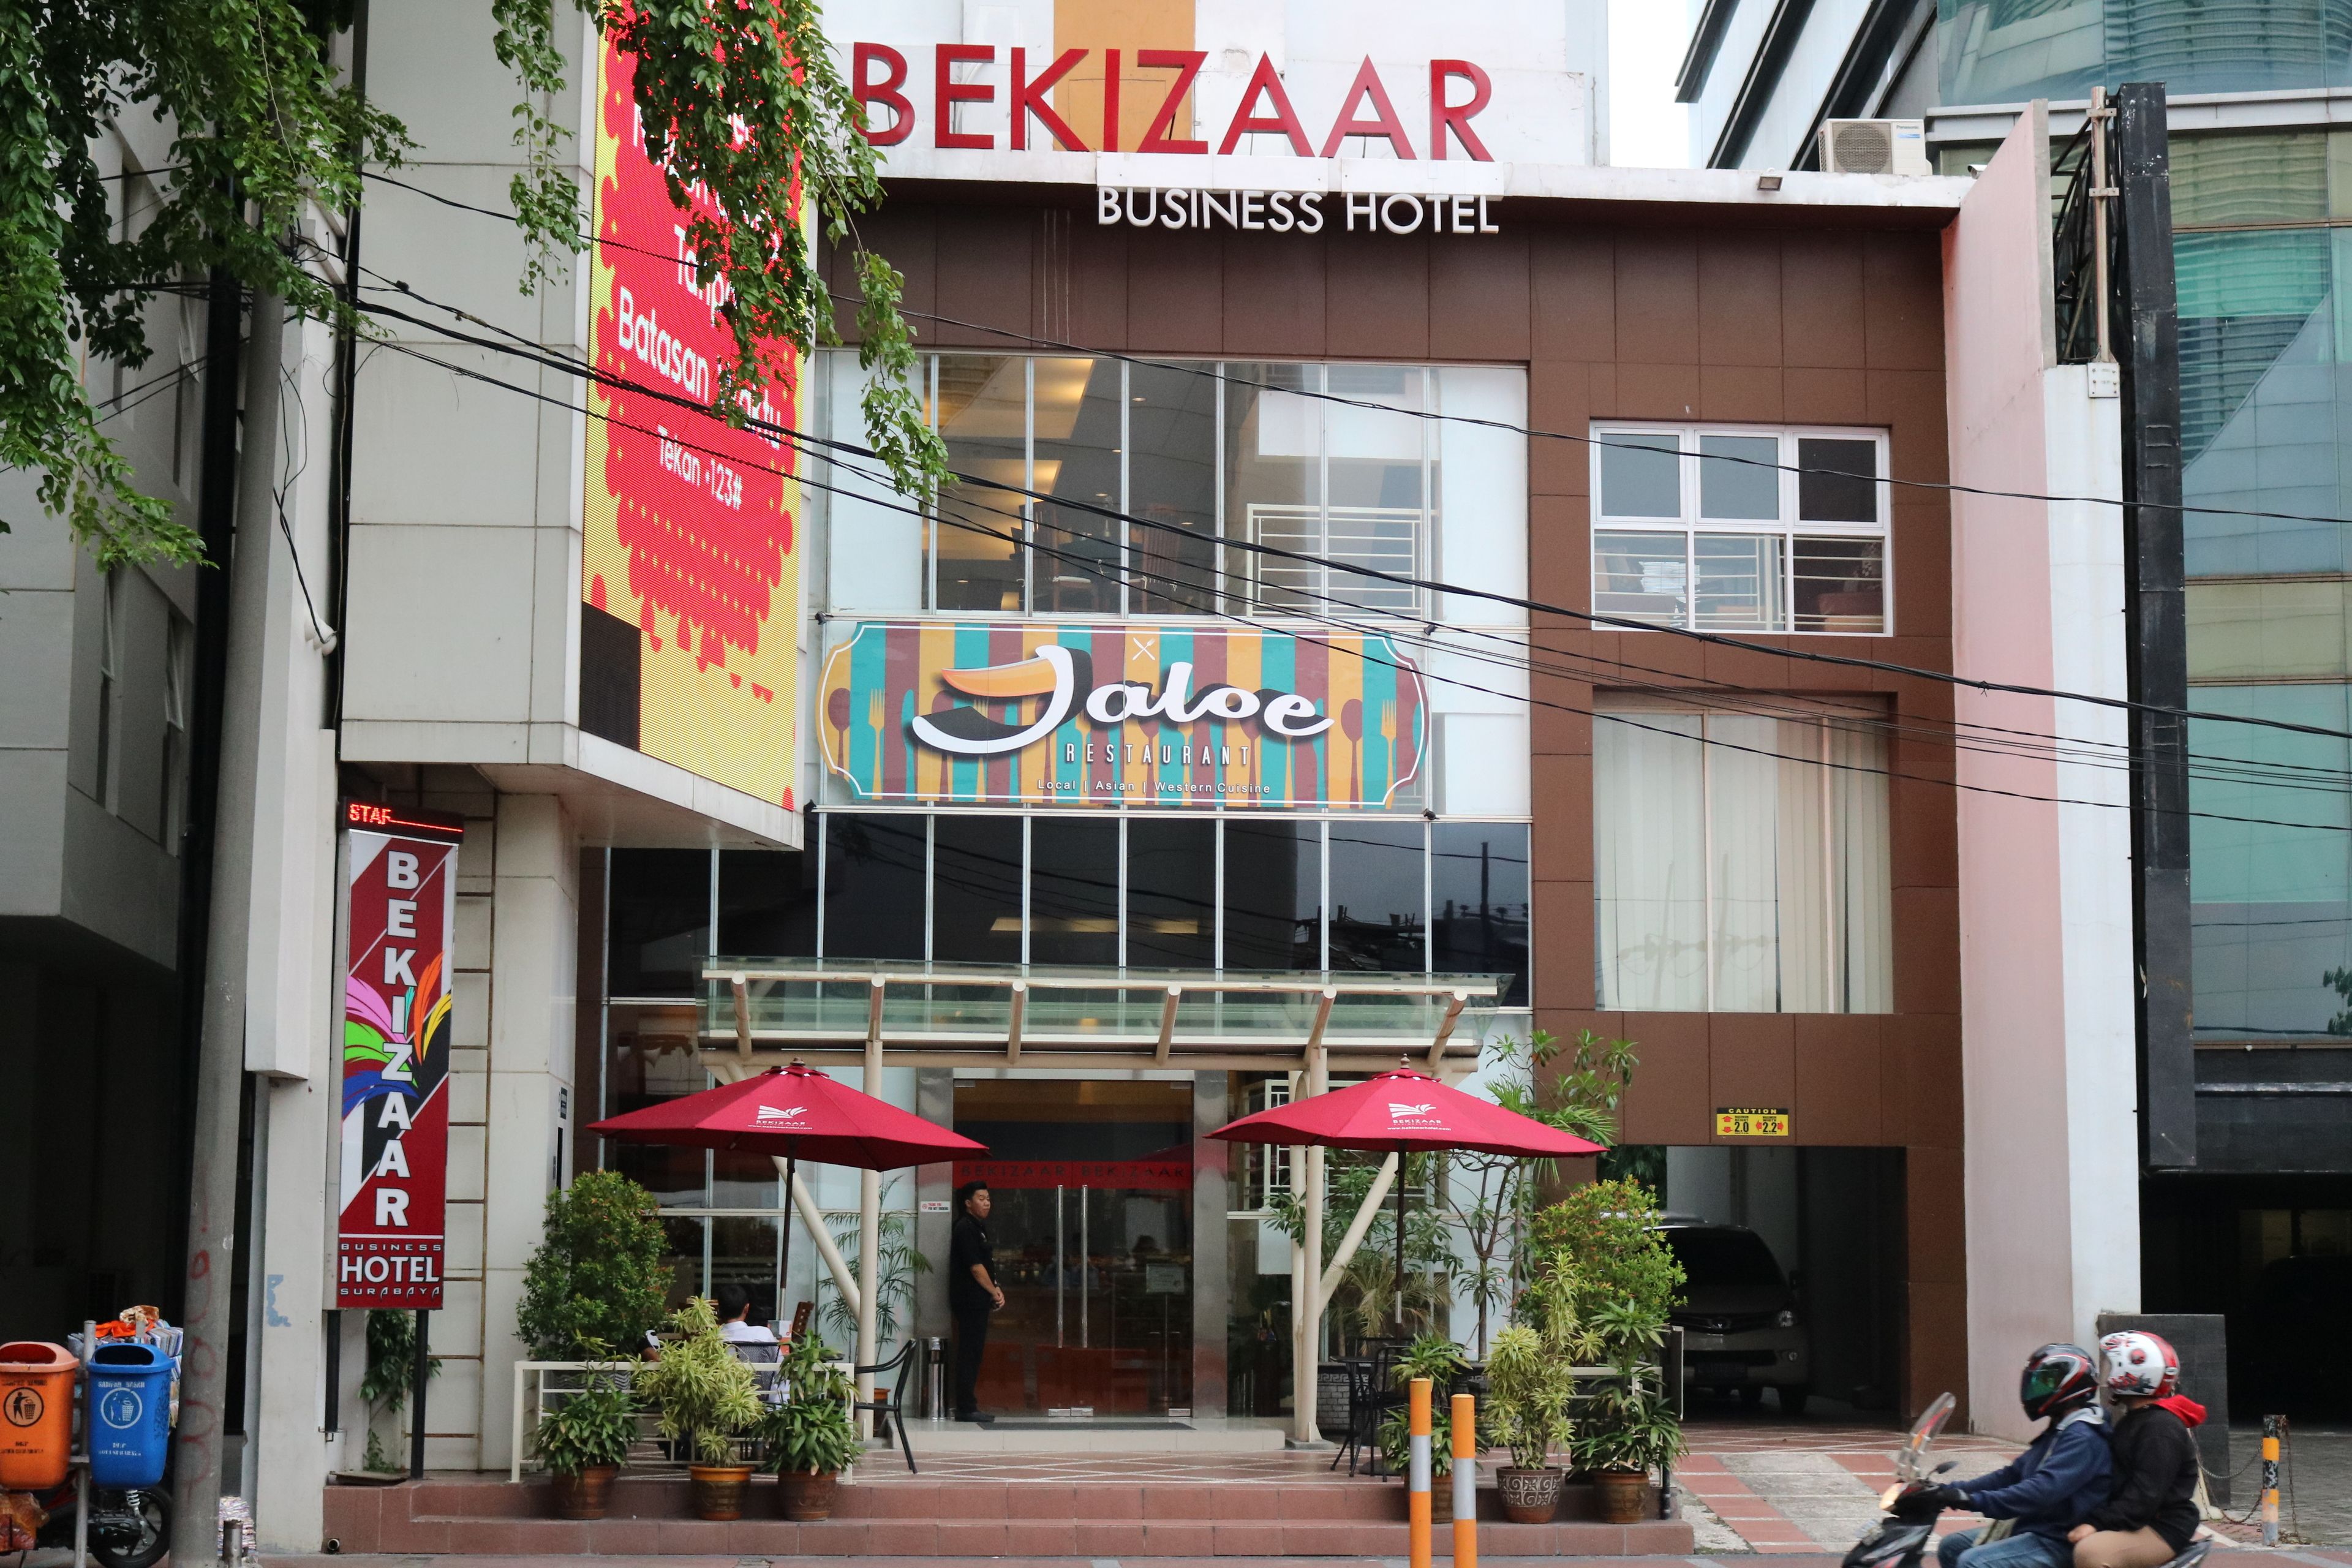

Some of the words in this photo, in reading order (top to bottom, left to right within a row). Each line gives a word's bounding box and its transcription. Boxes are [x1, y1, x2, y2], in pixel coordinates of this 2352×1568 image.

[852, 42, 1494, 162] BEKIZAAR
[1098, 187, 1324, 234] BUSINESS
[1347, 192, 1499, 235] HOTEL
[619, 286, 709, 404] Batasan
[657, 424, 701, 488] Tekan
[911, 644, 1336, 755] Jaloe
[1066, 742, 1249, 766] RESTAURANT
[1038, 779, 1076, 790] Local
[1095, 780, 1135, 791] Asian
[1154, 782, 1212, 793] Western
[1216, 782, 1270, 794] Cuisine
[375, 850, 420, 1227] BEKIZAAR
[1734, 1121, 1749, 1133] 2.0
[1762, 1121, 1777, 1133] 2.2
[340, 1286, 440, 1299] SURABAYA
[341, 1256, 440, 1283] HOTEL
